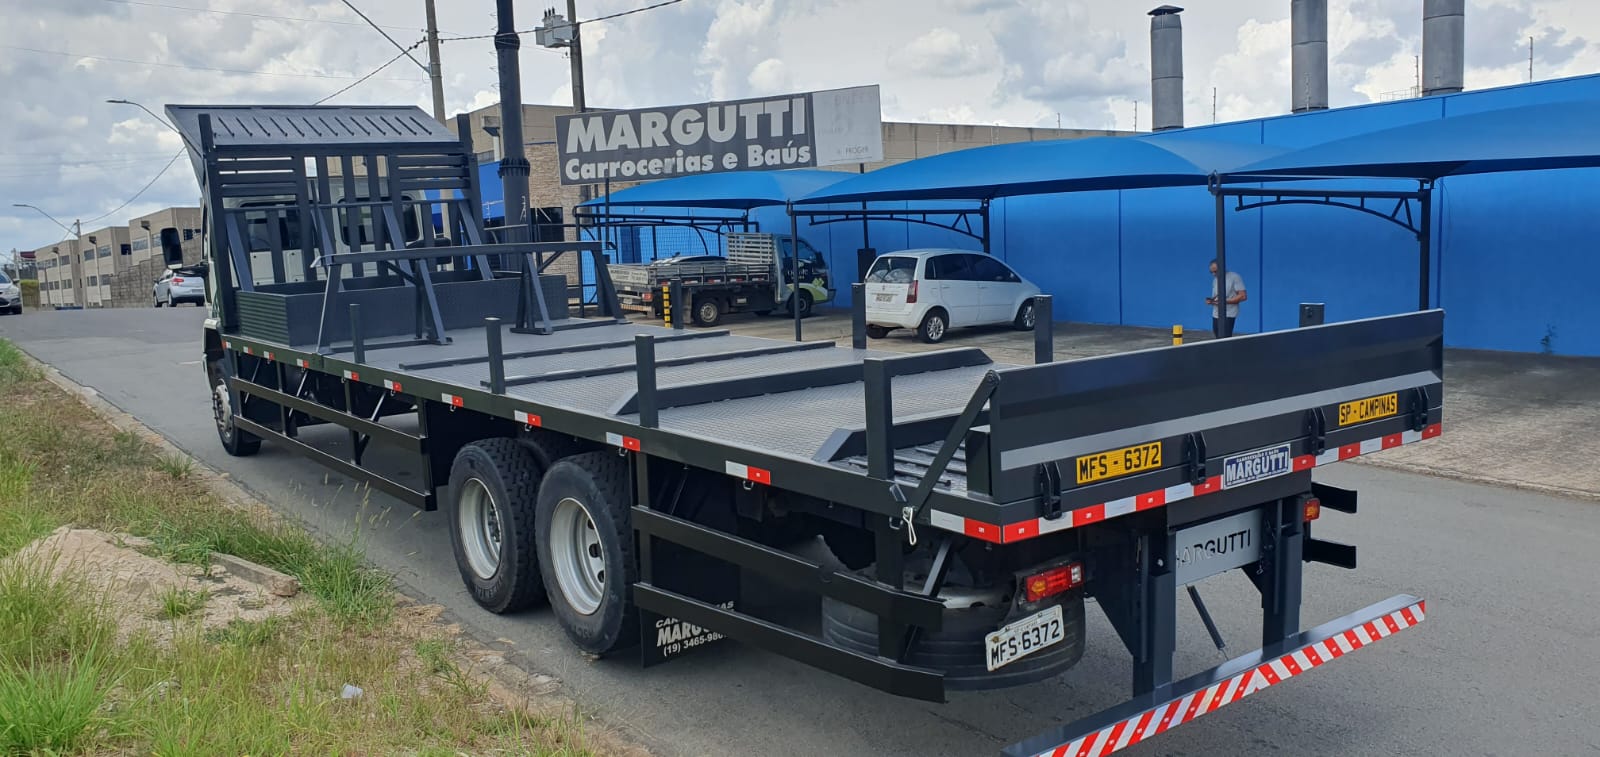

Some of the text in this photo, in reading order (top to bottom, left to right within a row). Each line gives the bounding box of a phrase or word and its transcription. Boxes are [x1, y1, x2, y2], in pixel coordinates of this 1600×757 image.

[566, 97, 806, 154] MARGUTTI
[565, 140, 811, 181] Carrocerias e Baús
[1340, 405, 1351, 423] SP
[1359, 395, 1396, 419] CAMPINAS
[1079, 455, 1107, 481] MFS
[1123, 445, 1160, 471] 6372
[1226, 451, 1288, 483] MARGUTTI
[663, 643, 681, 657] (19)
